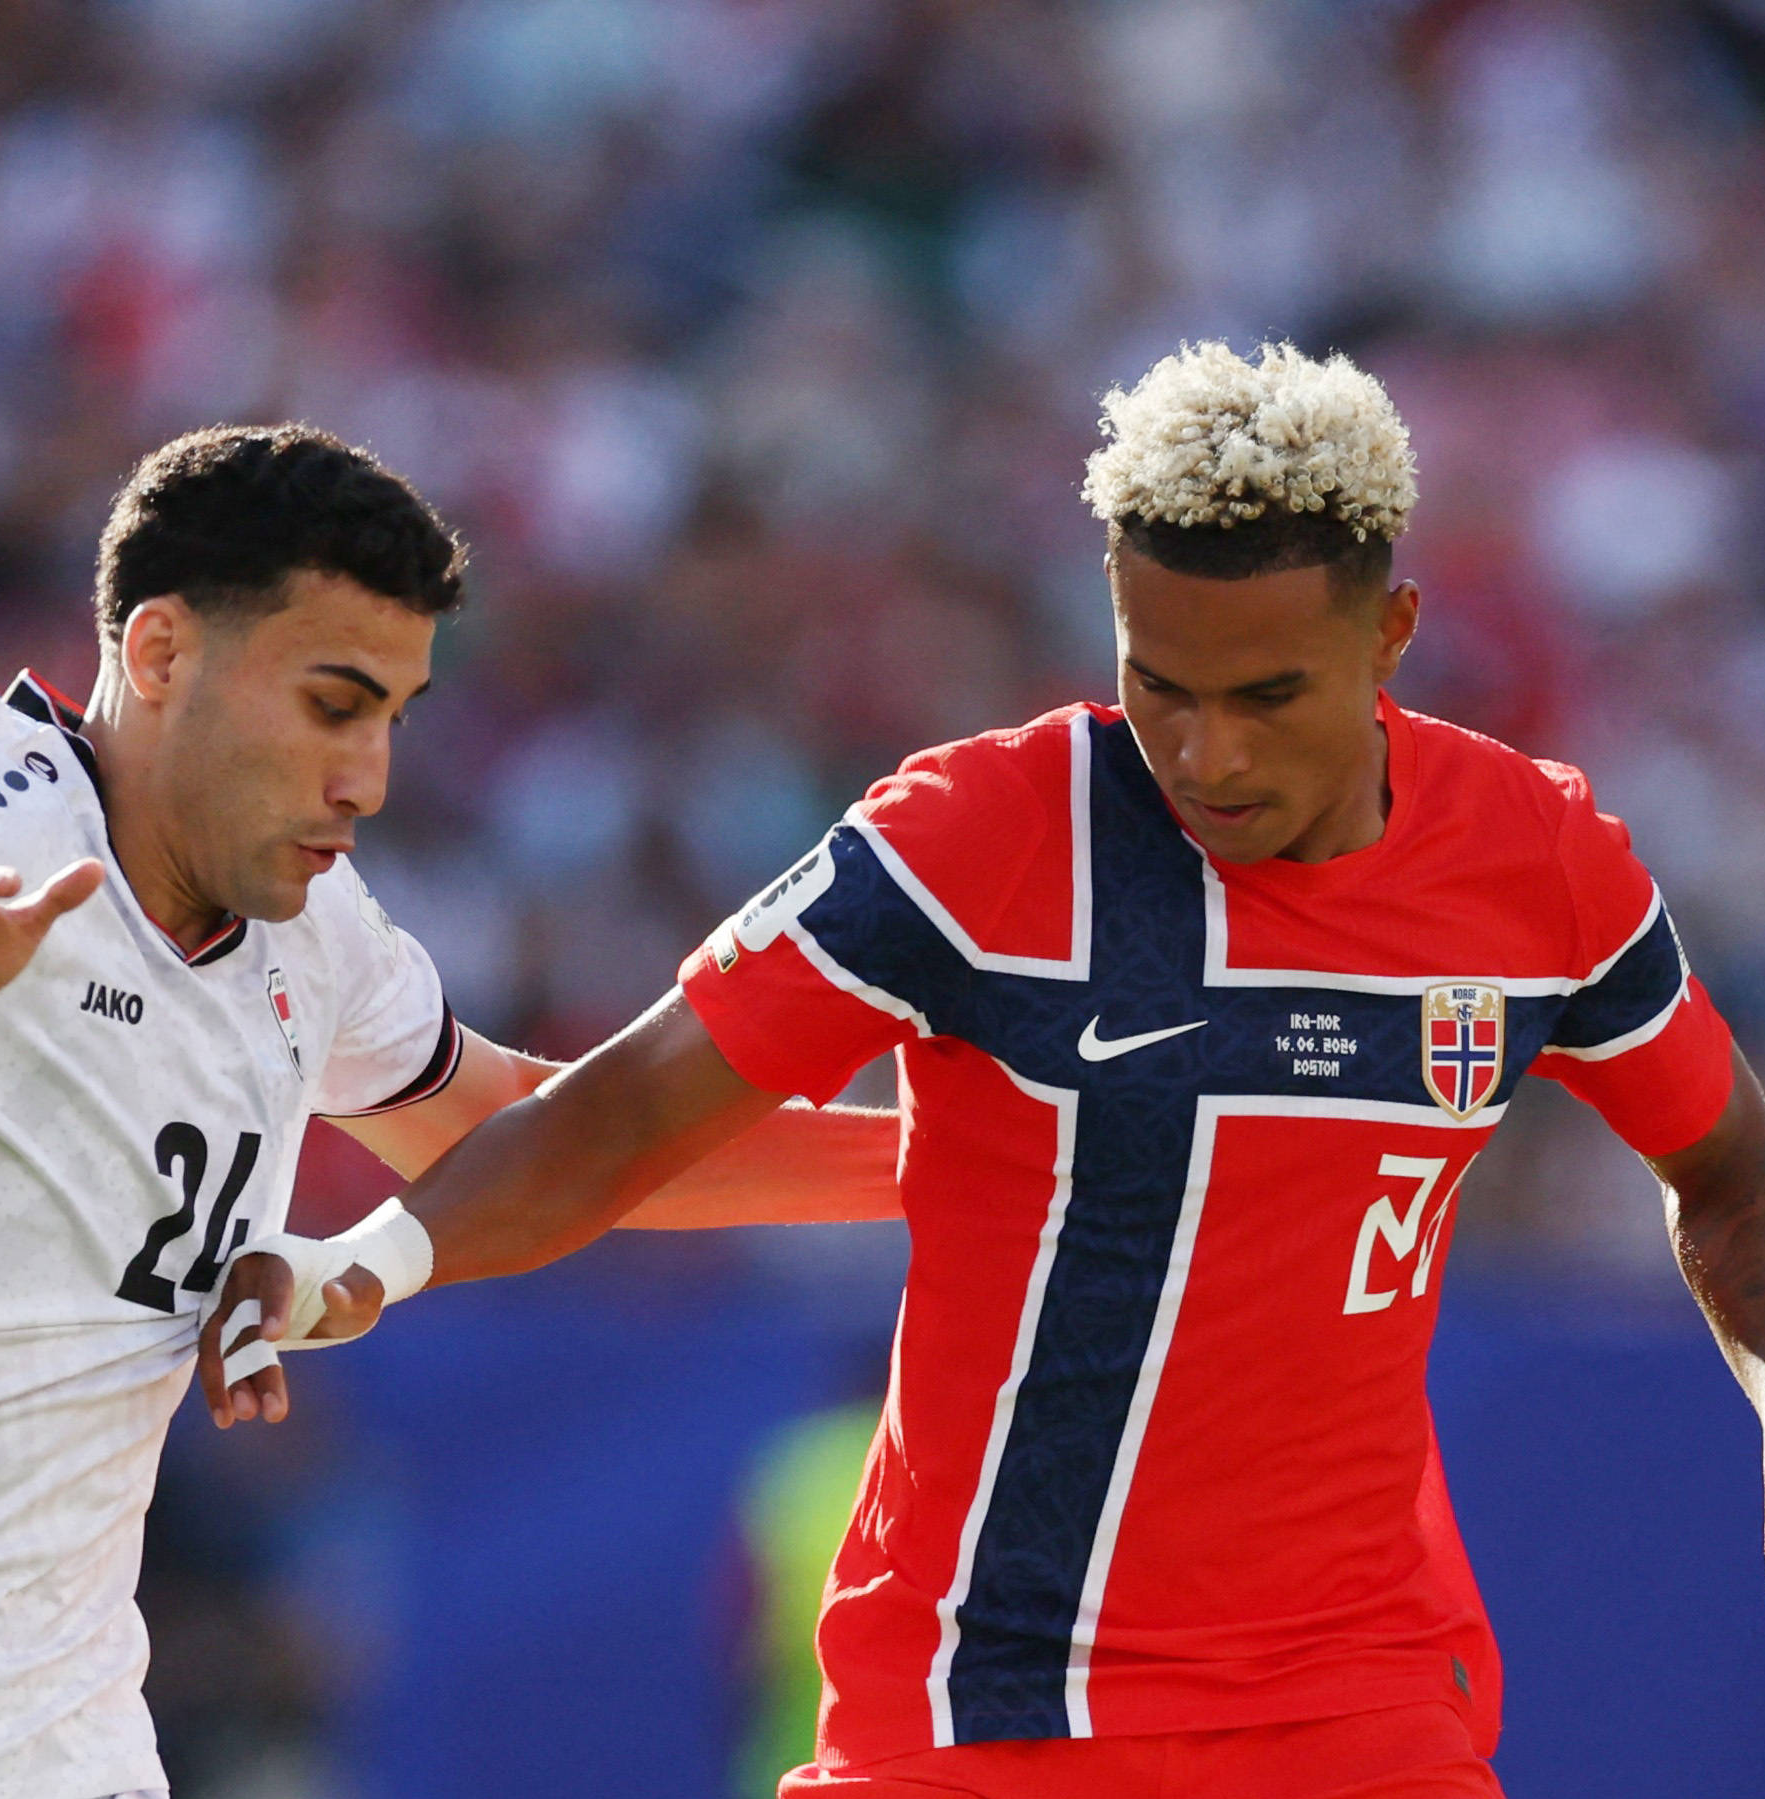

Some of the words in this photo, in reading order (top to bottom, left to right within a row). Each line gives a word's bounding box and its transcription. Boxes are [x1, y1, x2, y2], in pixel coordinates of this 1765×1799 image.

[79, 980, 144, 1025] JAKO
[1289, 1012, 1341, 1032] IRQ-NOR
[1292, 1058, 1341, 1078] BOSTON
[114, 1121, 263, 1315] 24
